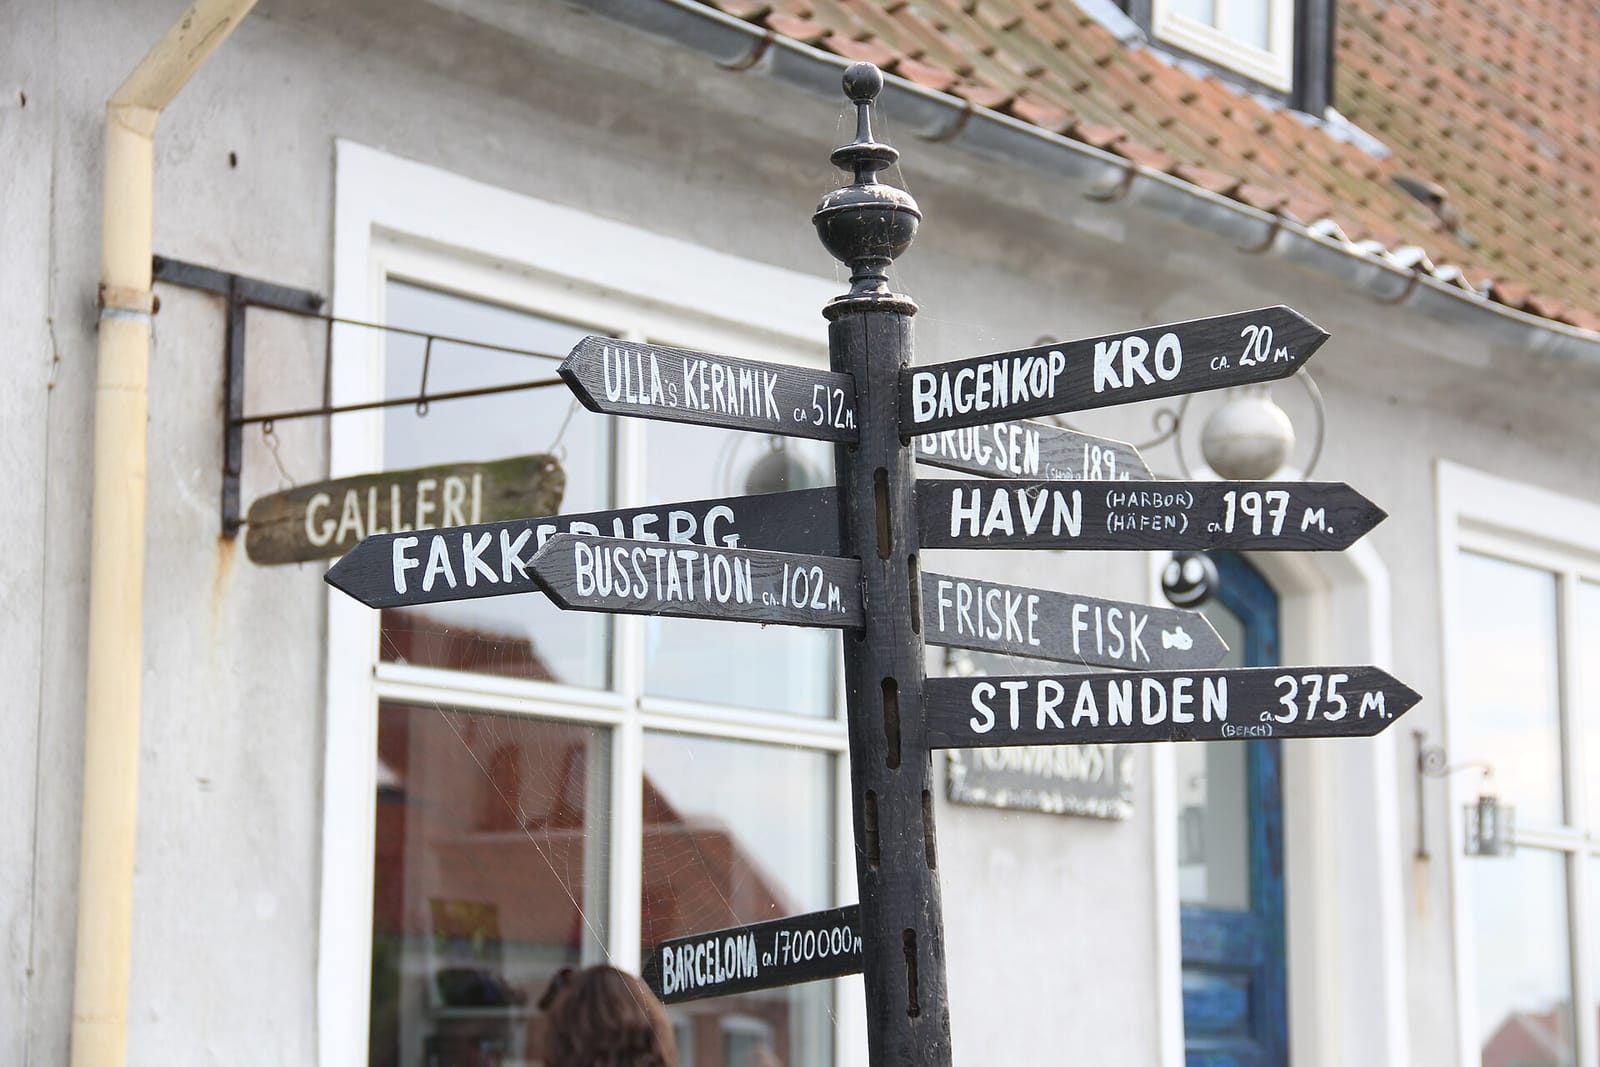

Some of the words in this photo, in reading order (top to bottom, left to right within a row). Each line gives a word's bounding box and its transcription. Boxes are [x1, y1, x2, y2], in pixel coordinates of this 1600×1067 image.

[683, 358, 781, 421] KERAMIK
[912, 350, 1067, 424] BAGENKOP
[1093, 332, 1184, 393] KRO
[304, 473, 483, 547] GALLERI
[950, 487, 1083, 538] HAVN
[1105, 489, 1195, 509] (HARBOR)
[1223, 490, 1291, 536] 197
[1301, 507, 1335, 534] M.
[1106, 511, 1189, 535] (HÄFEN)
[392, 505, 741, 594] FAKKERG
[574, 541, 754, 604] BUSSTATION
[937, 580, 1041, 647] FRISKE
[1072, 603, 1152, 663] FISK
[969, 676, 1229, 734] STRANDEN
[1274, 674, 1349, 724] 375
[1358, 691, 1394, 719] M.
[1221, 722, 1273, 737] (BEACH)
[662, 931, 759, 996] BARCELONA
